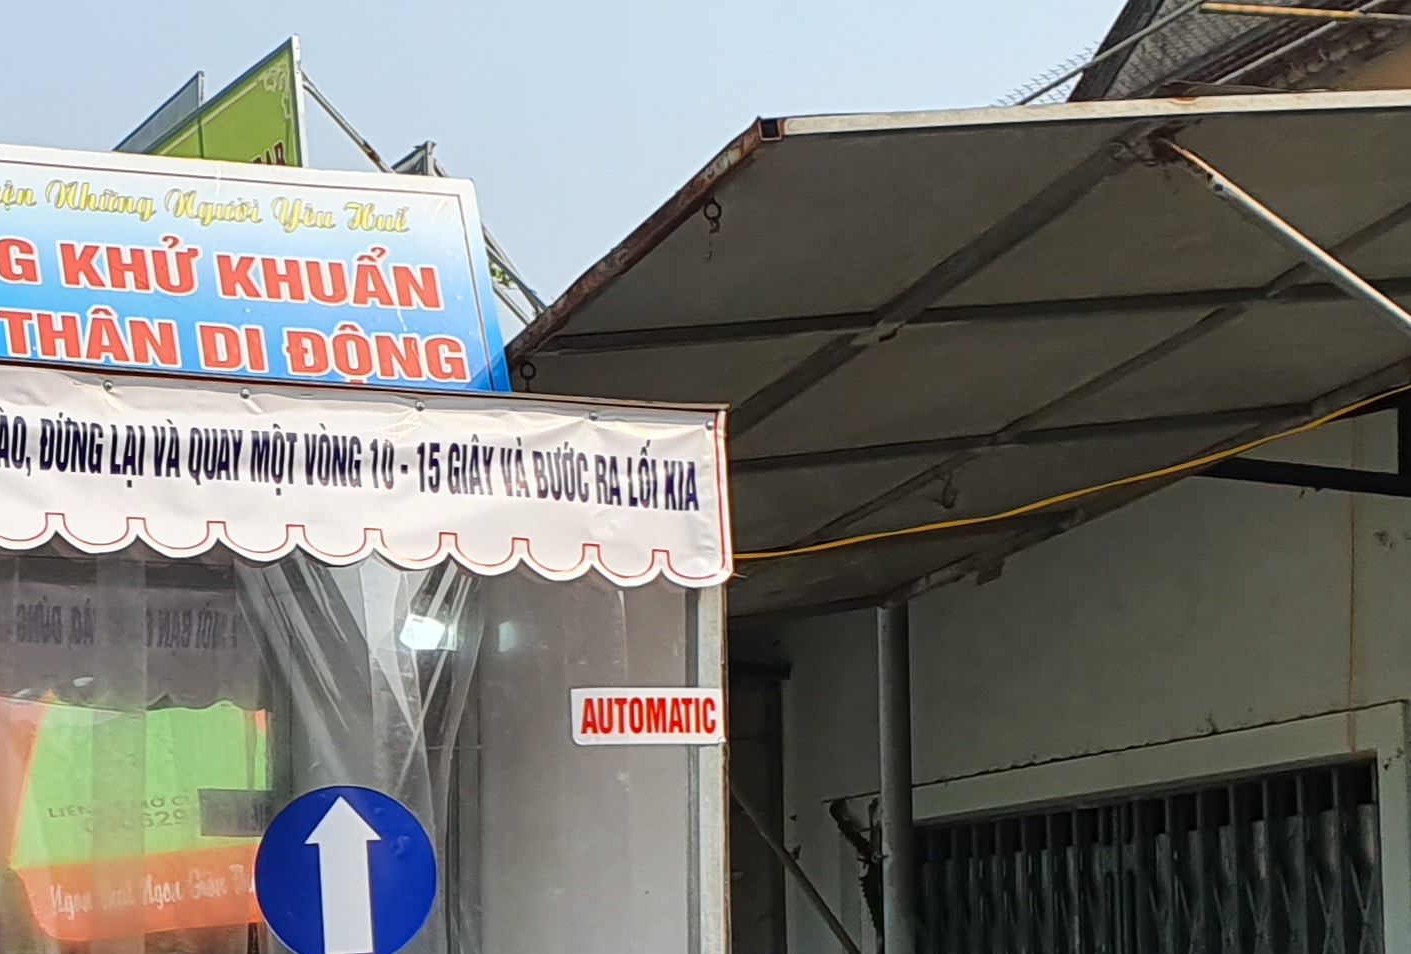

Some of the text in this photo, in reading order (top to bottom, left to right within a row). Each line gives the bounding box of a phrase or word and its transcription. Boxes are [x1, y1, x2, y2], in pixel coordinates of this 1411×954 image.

[45, 179, 157, 222] Những
[164, 188, 263, 227] Người
[270, 196, 336, 233] Yêu
[344, 201, 410, 232] Huế
[59, 235, 200, 294] KHỬ
[216, 246, 443, 309] KHUẨN
[199, 324, 269, 371] DI
[285, 323, 468, 385] ĐỘNG
[39, 412, 104, 474] ĐỨNG
[110, 424, 145, 488] LẠI
[152, 419, 181, 478] VÀ
[188, 427, 244, 486] QUAY
[250, 423, 298, 496] MỘT
[304, 423, 362, 488] VÒNG
[369, 438, 394, 490] 10
[417, 442, 441, 493] 15
[447, 434, 495, 496] GIÂY
[500, 437, 531, 498] VÀ
[532, 442, 590, 503] BƯỚC
[595, 454, 622, 506] RA
[627, 440, 658, 509] LỐI
[664, 460, 700, 512] KIA
[580, 697, 717, 735] AUTOMATIC
